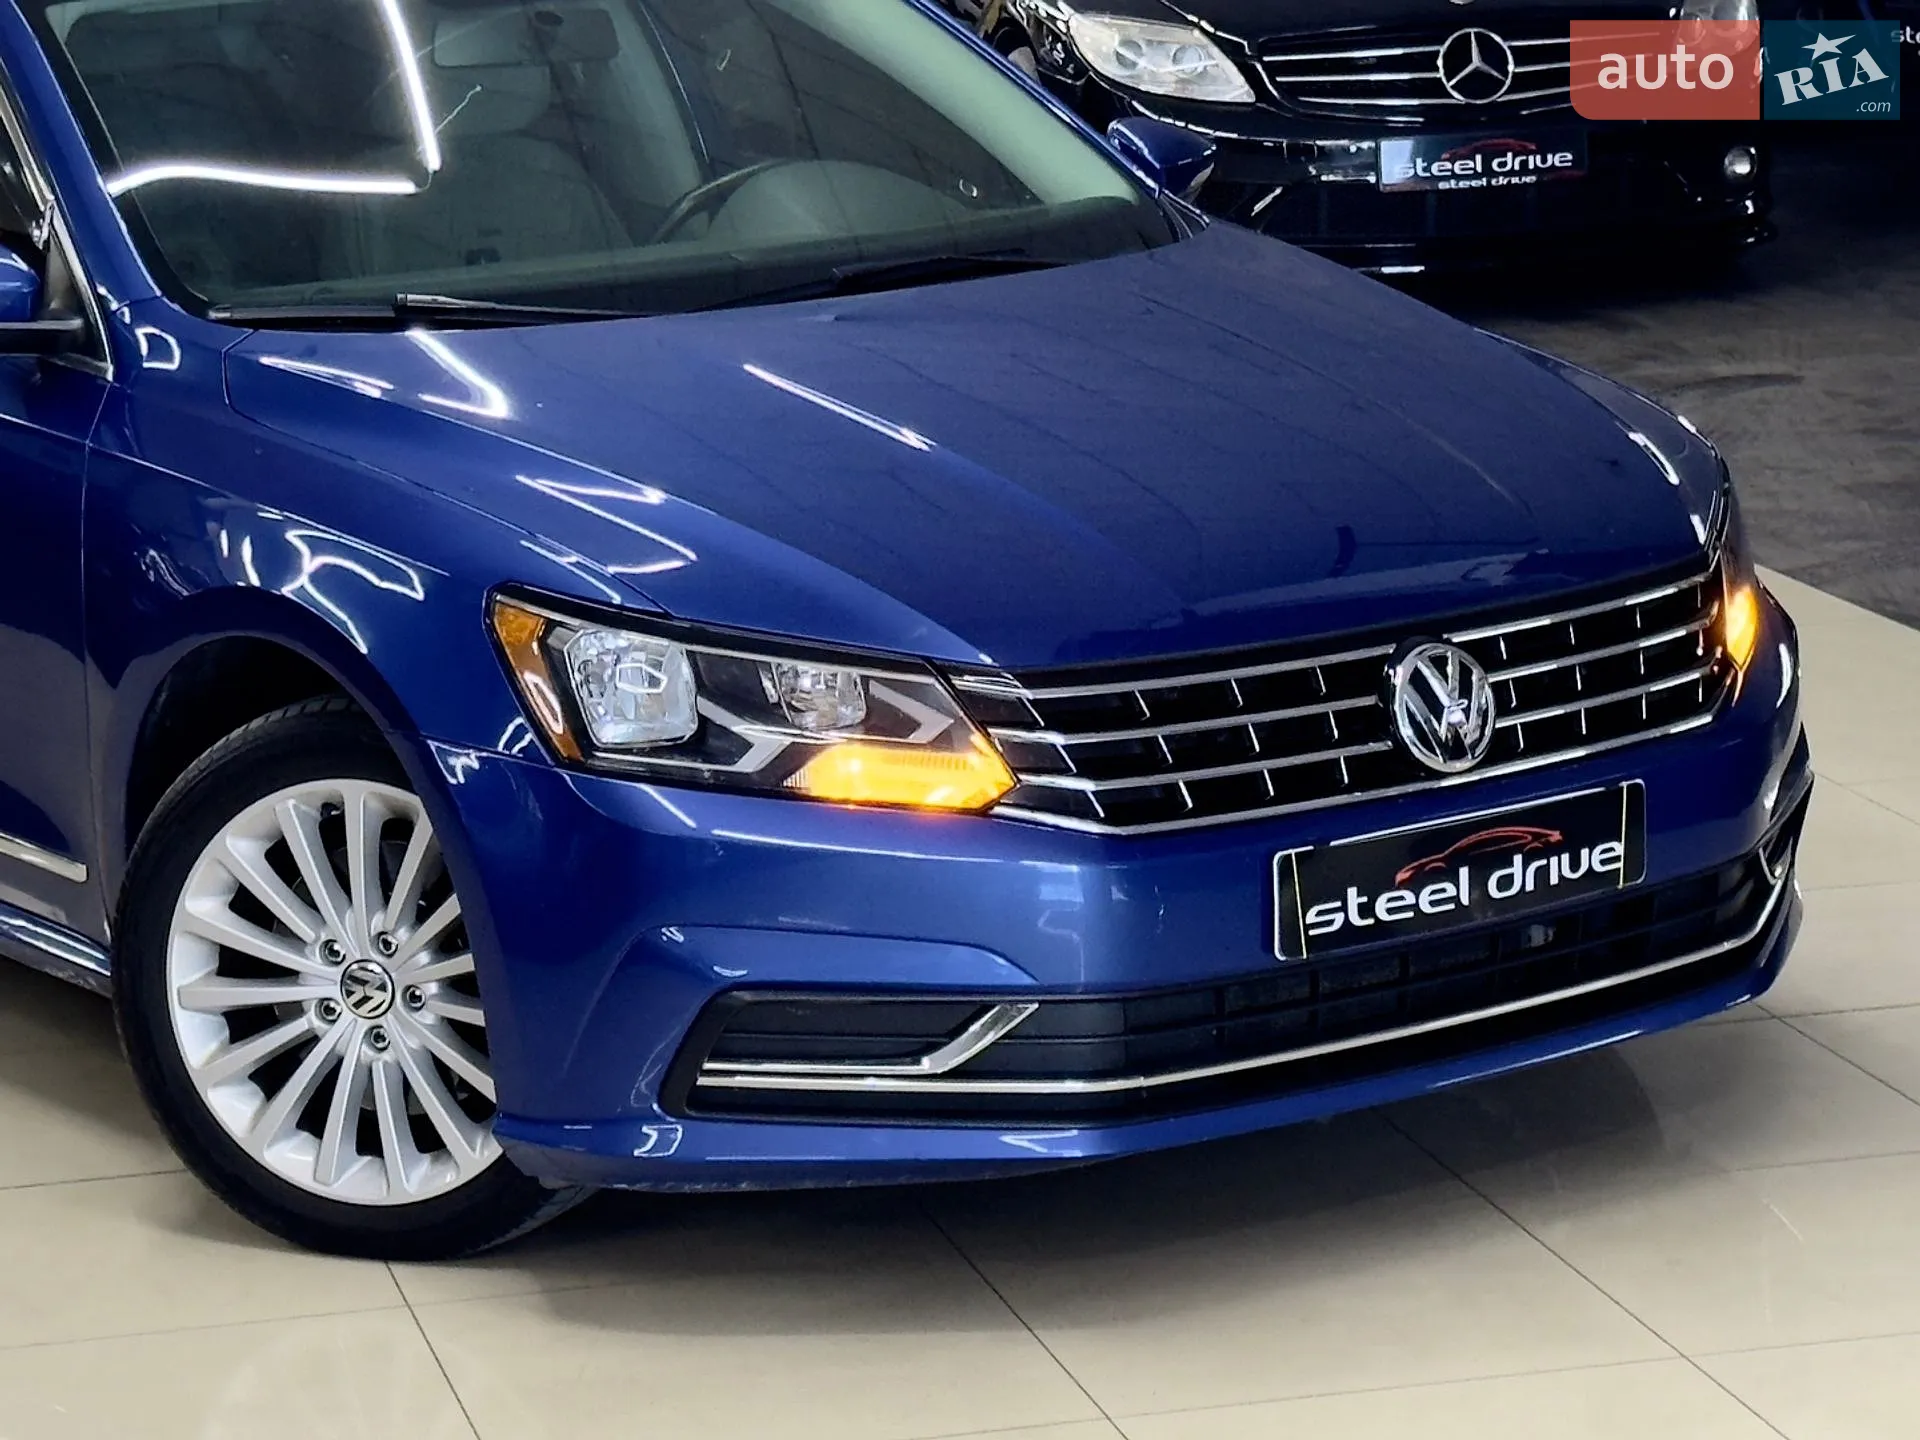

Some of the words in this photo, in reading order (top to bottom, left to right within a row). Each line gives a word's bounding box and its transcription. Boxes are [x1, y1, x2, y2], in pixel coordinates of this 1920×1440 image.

[1394, 153, 1482, 179] steel
[1491, 151, 1573, 173] drive
[1438, 177, 1487, 190] steel
[1491, 174, 1538, 187] drive
[1305, 865, 1470, 936] steel
[1487, 840, 1623, 900] drive
